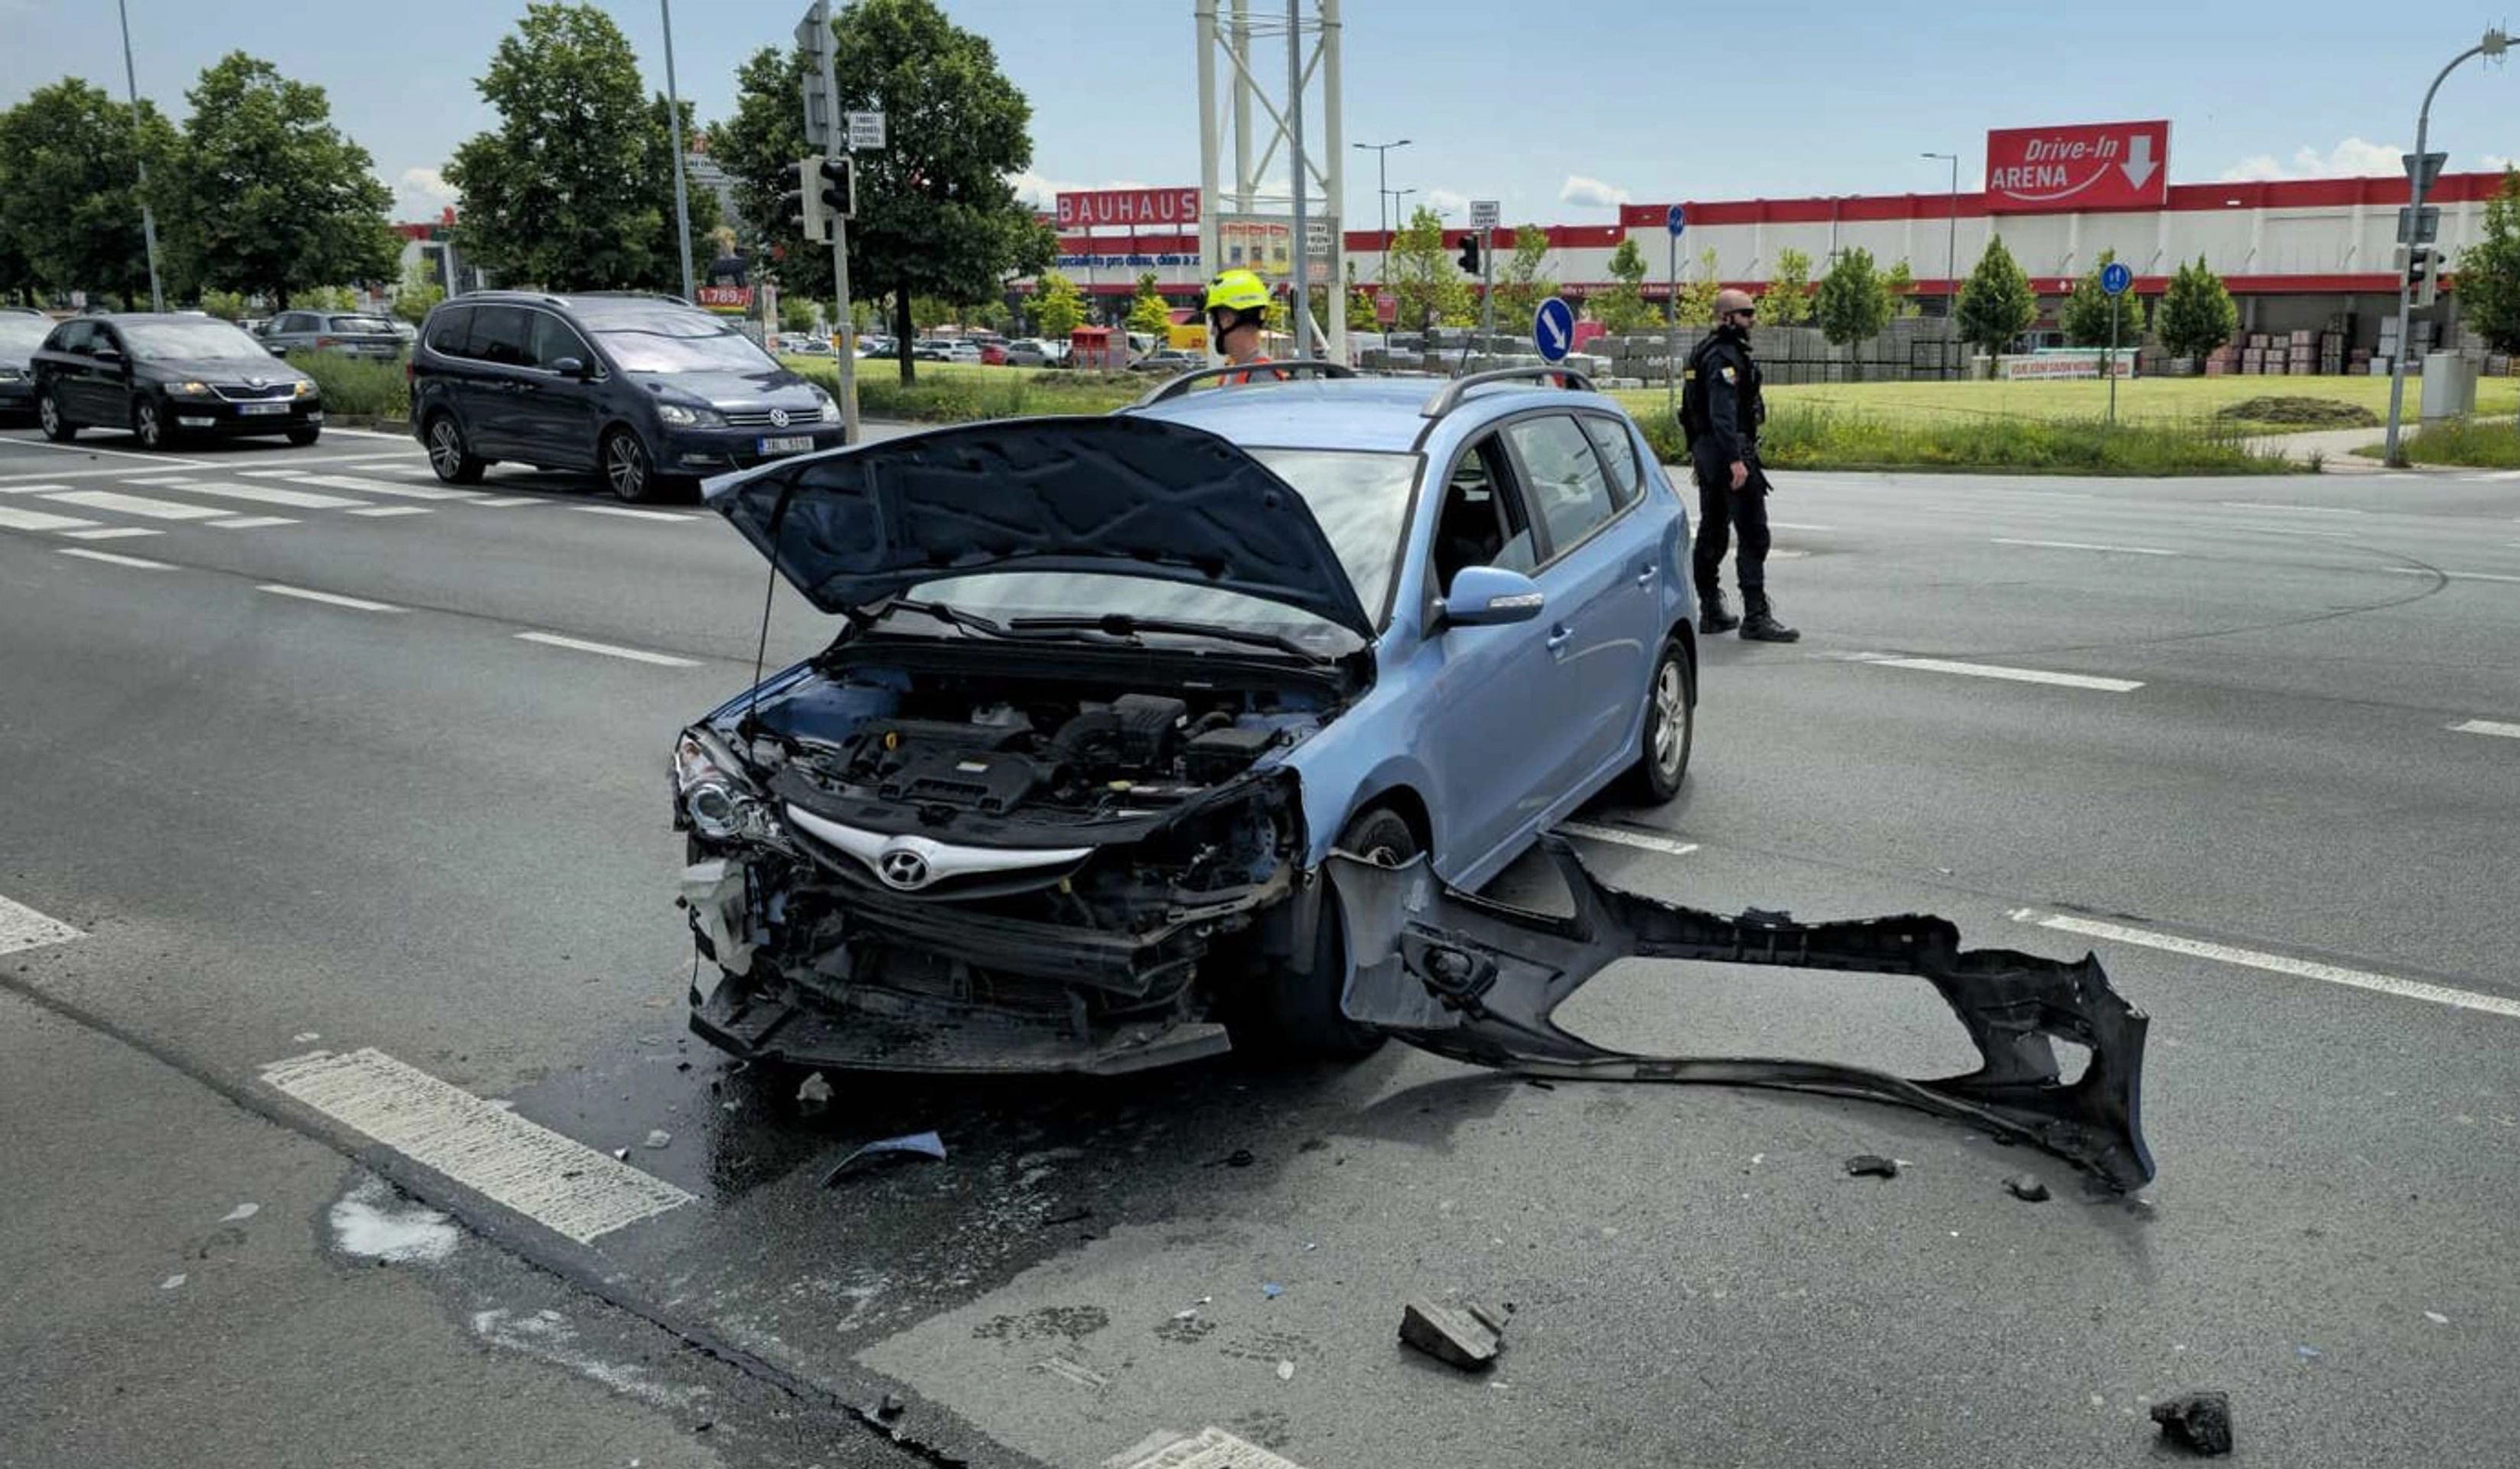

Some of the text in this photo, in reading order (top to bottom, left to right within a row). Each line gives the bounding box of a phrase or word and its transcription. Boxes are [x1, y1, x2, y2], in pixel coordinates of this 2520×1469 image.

[2026, 136, 2118, 161] Drive-In
[1991, 166, 2067, 188] ARENA
[1060, 194, 1197, 222] BAUHAUS
[1105, 256, 1125, 269] pro
